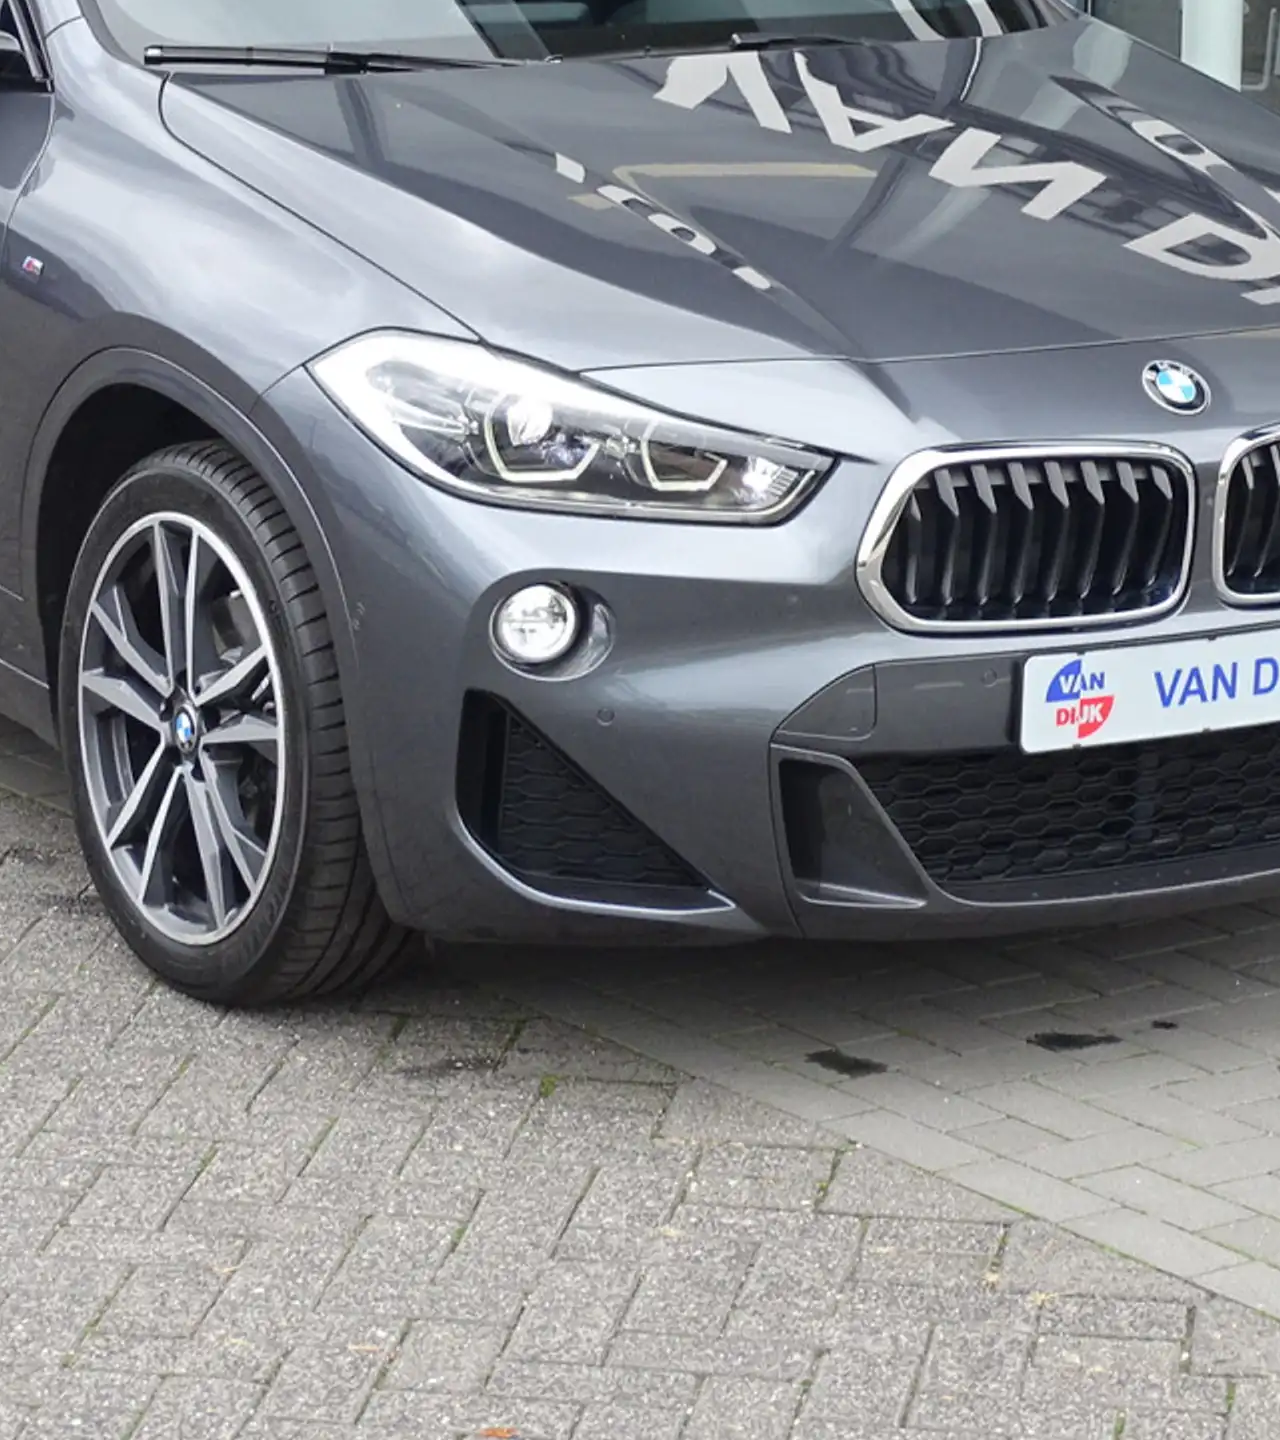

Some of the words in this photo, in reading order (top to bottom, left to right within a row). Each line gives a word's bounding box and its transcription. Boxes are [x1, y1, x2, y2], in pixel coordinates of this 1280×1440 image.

[1058, 671, 1106, 695] VAN
[1154, 661, 1239, 709] VAN
[1055, 703, 1105, 727] DIJK
